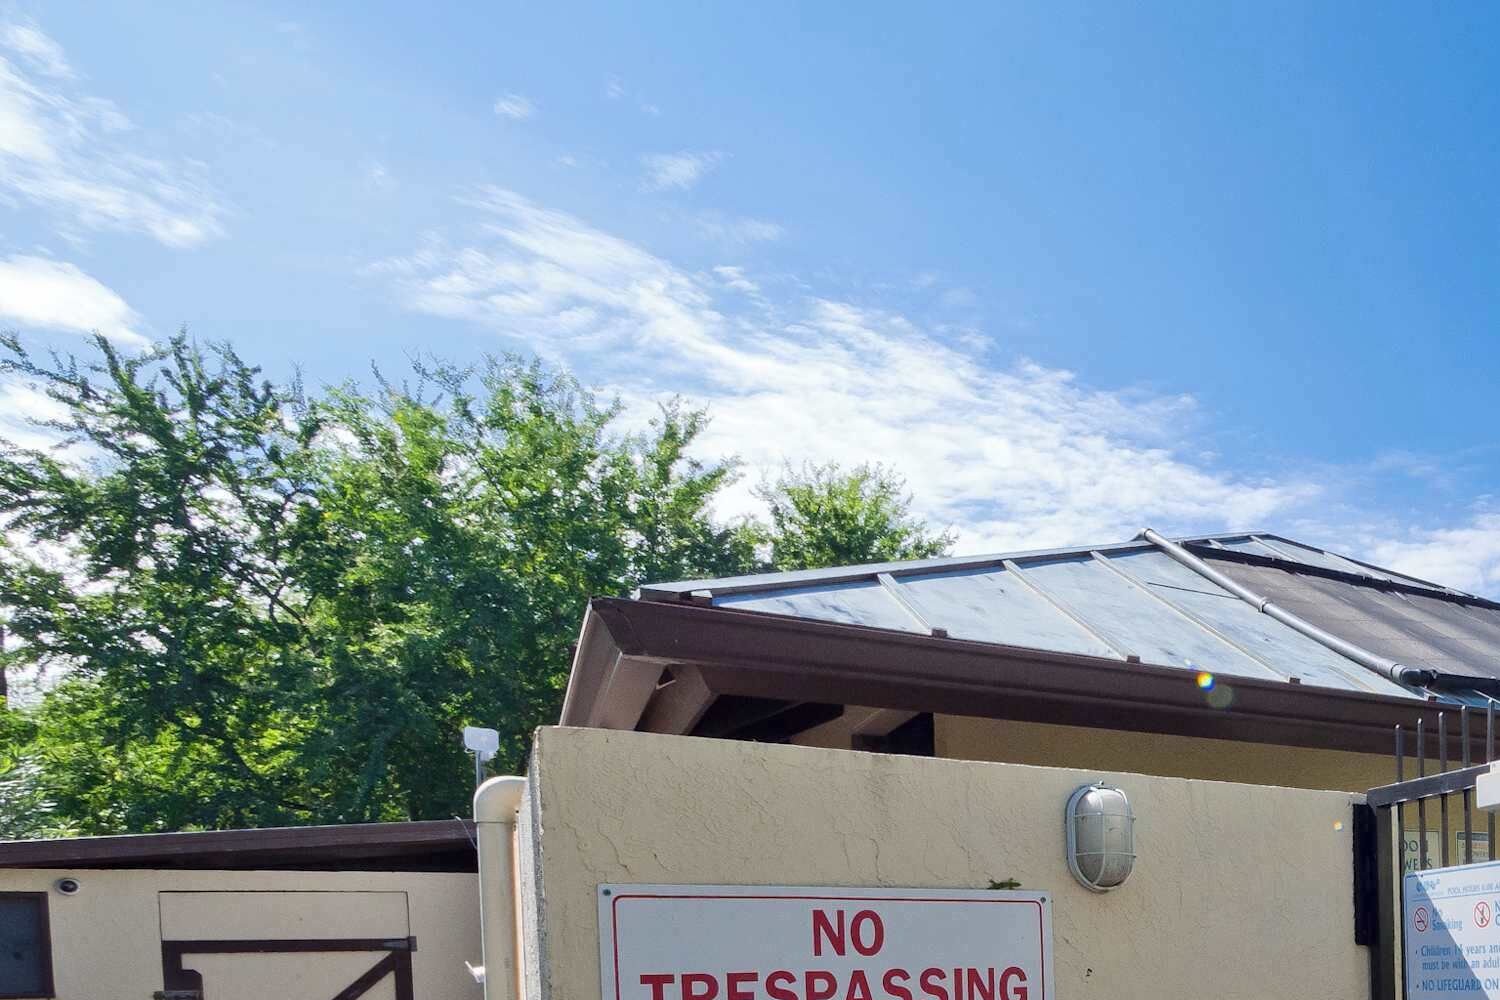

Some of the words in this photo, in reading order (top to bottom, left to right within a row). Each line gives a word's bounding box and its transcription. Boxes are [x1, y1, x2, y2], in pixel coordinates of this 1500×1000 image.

[812, 909, 885, 957] NO
[1421, 945, 1451, 957] Children
[1466, 945, 1486, 956] years
[1422, 960, 1439, 970] must
[1441, 959, 1450, 970] be
[1471, 960, 1480, 968] an
[1422, 980, 1435, 991] NO
[1437, 978, 1482, 991] LIFEGUARD
[1485, 978, 1499, 990] ON
